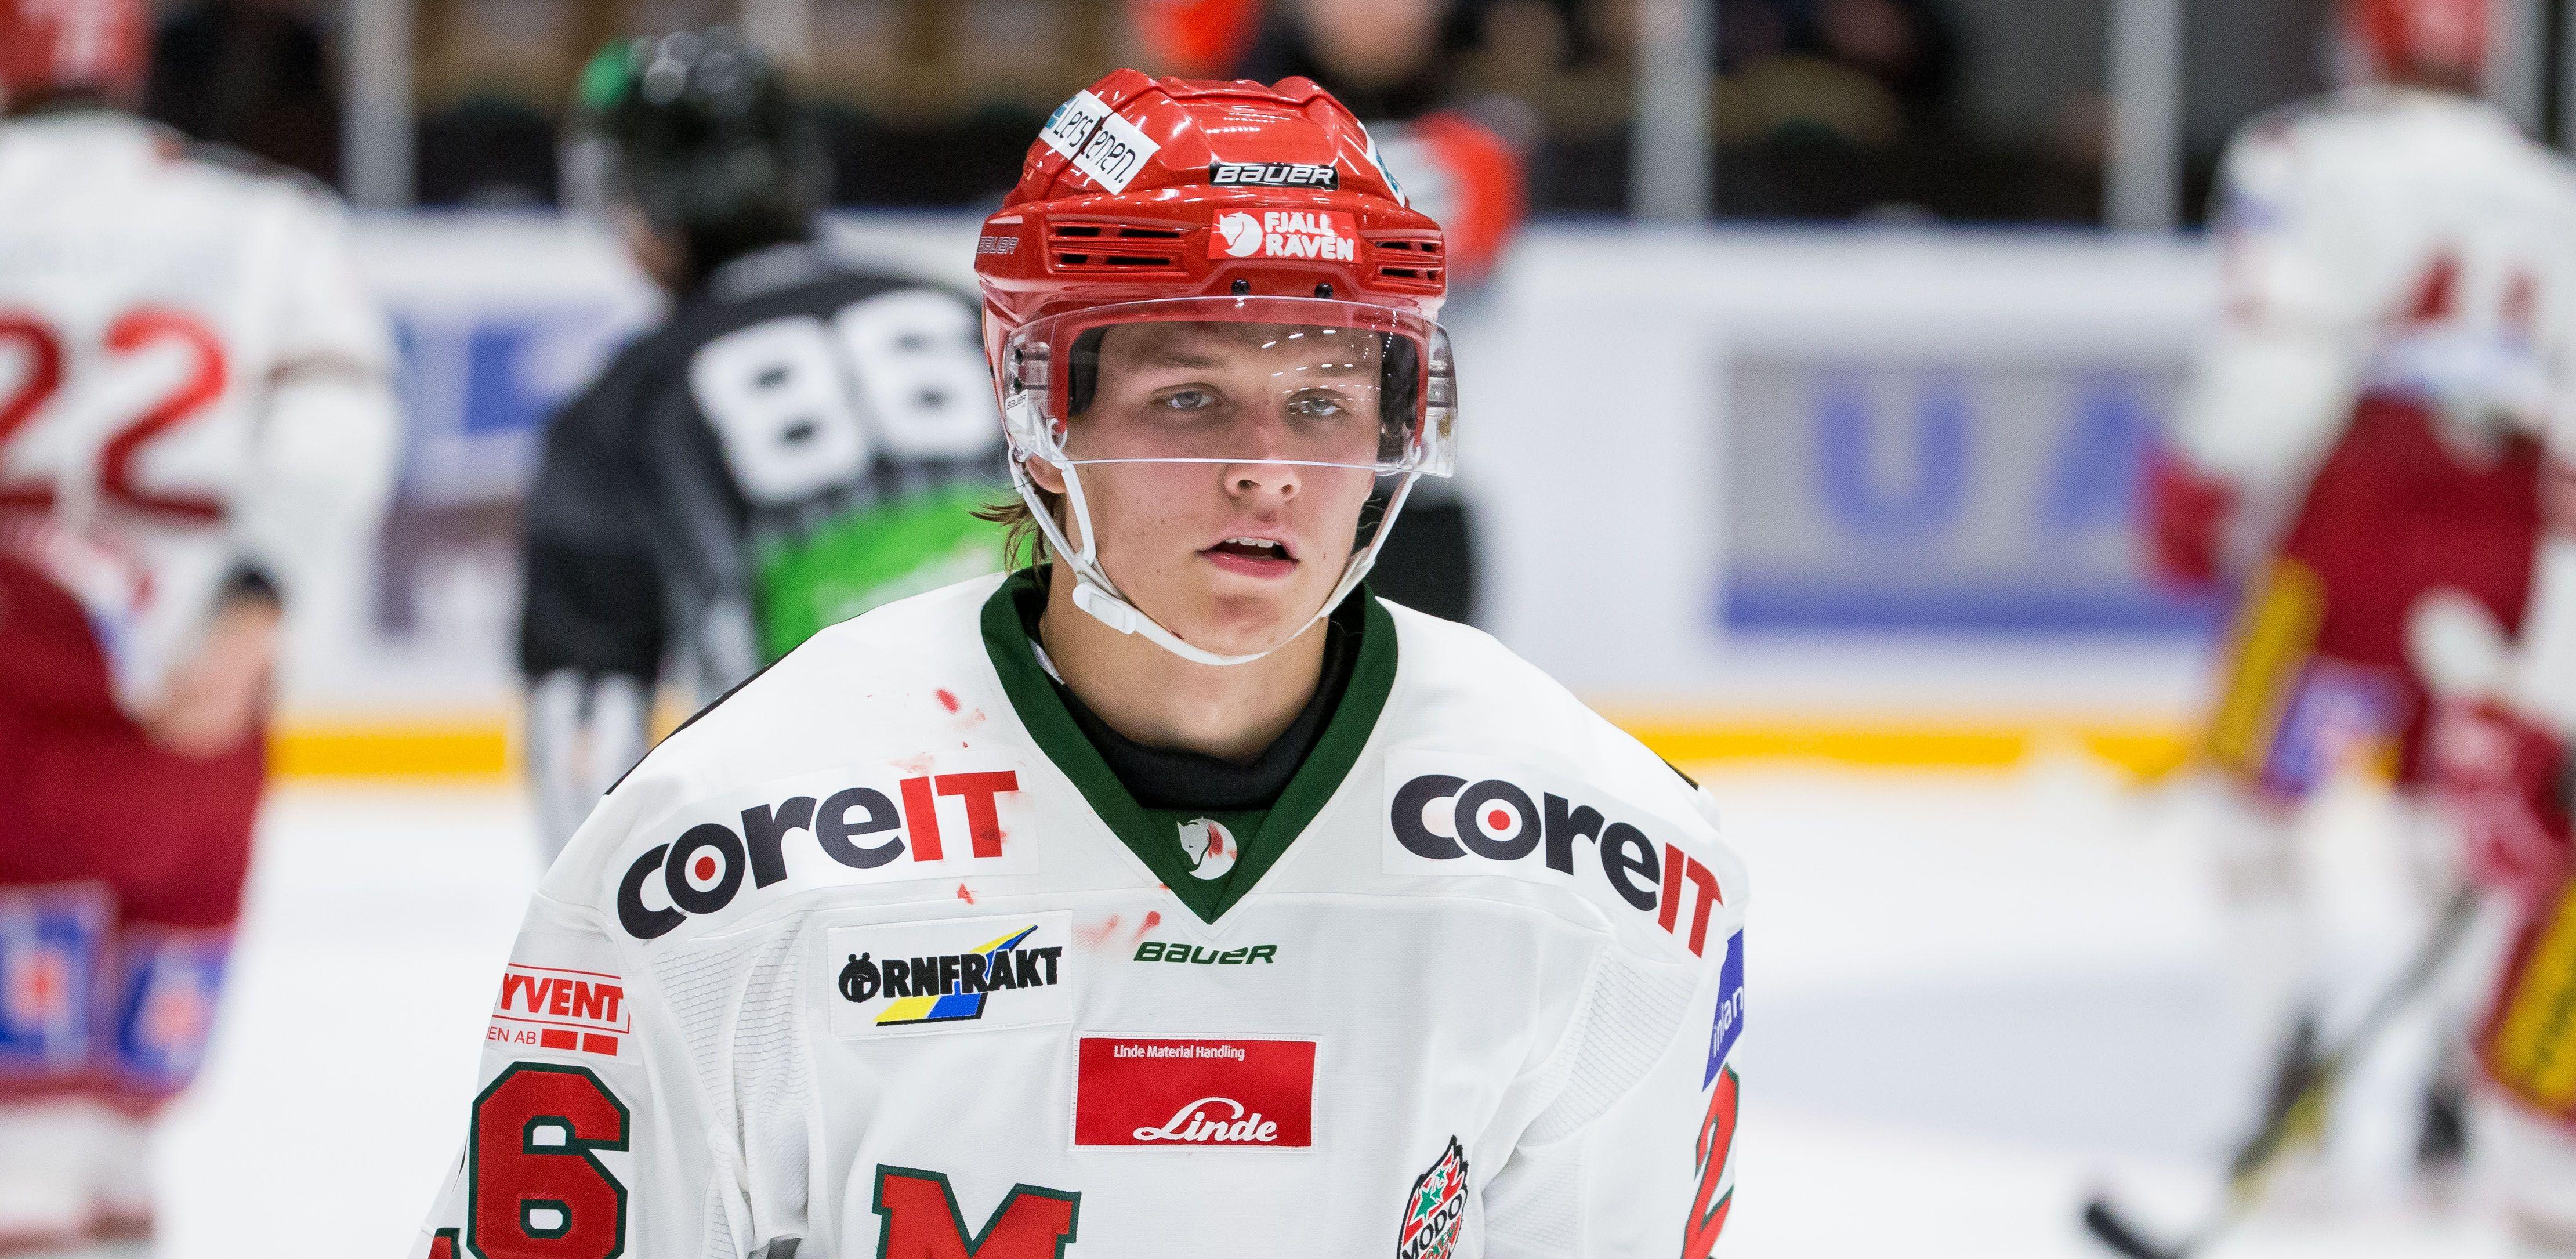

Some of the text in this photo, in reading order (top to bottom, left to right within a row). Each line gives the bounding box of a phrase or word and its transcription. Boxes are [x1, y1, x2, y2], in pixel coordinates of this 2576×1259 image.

[1213, 166, 1334, 184] BAUER
[1264, 211, 1336, 237] FJÄLL
[1266, 233, 1354, 261] RÄVEN
[690, 288, 1003, 508] 86
[617, 769, 1019, 940] coreIT
[1391, 774, 1724, 959] coreIT
[1133, 942, 1277, 964] BAUER
[838, 946, 1063, 1003] ÖRNFRAKT
[486, 1026, 536, 1044] EN AB
[1114, 1044, 1246, 1061] Linde Material Handling
[1133, 1097, 1278, 1142] Linde
[427, 1061, 630, 1259] 6
